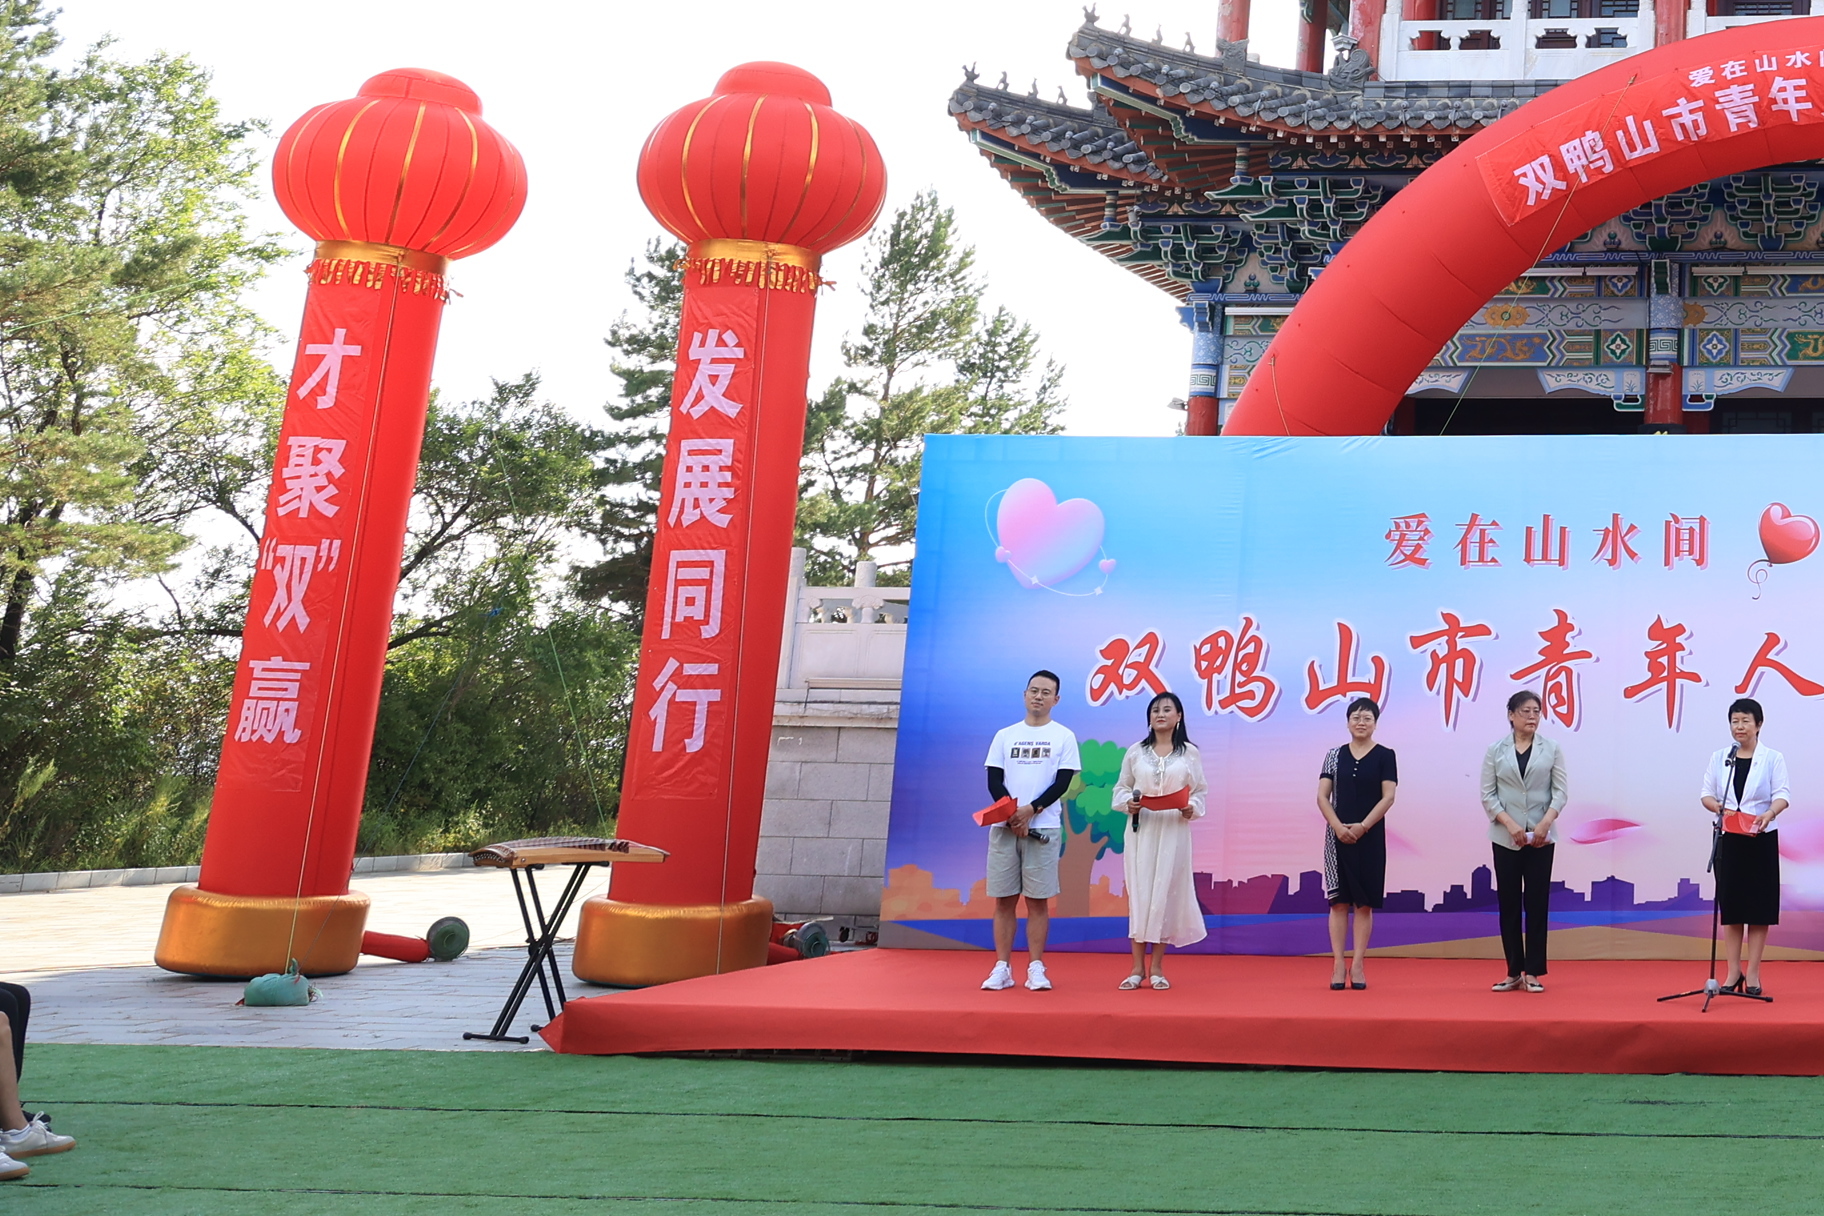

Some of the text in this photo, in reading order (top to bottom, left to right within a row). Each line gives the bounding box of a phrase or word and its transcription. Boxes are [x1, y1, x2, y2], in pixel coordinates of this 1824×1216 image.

[648, 328, 745, 754] 发展同行
[1385, 512, 1710, 568] 爱在山水间
